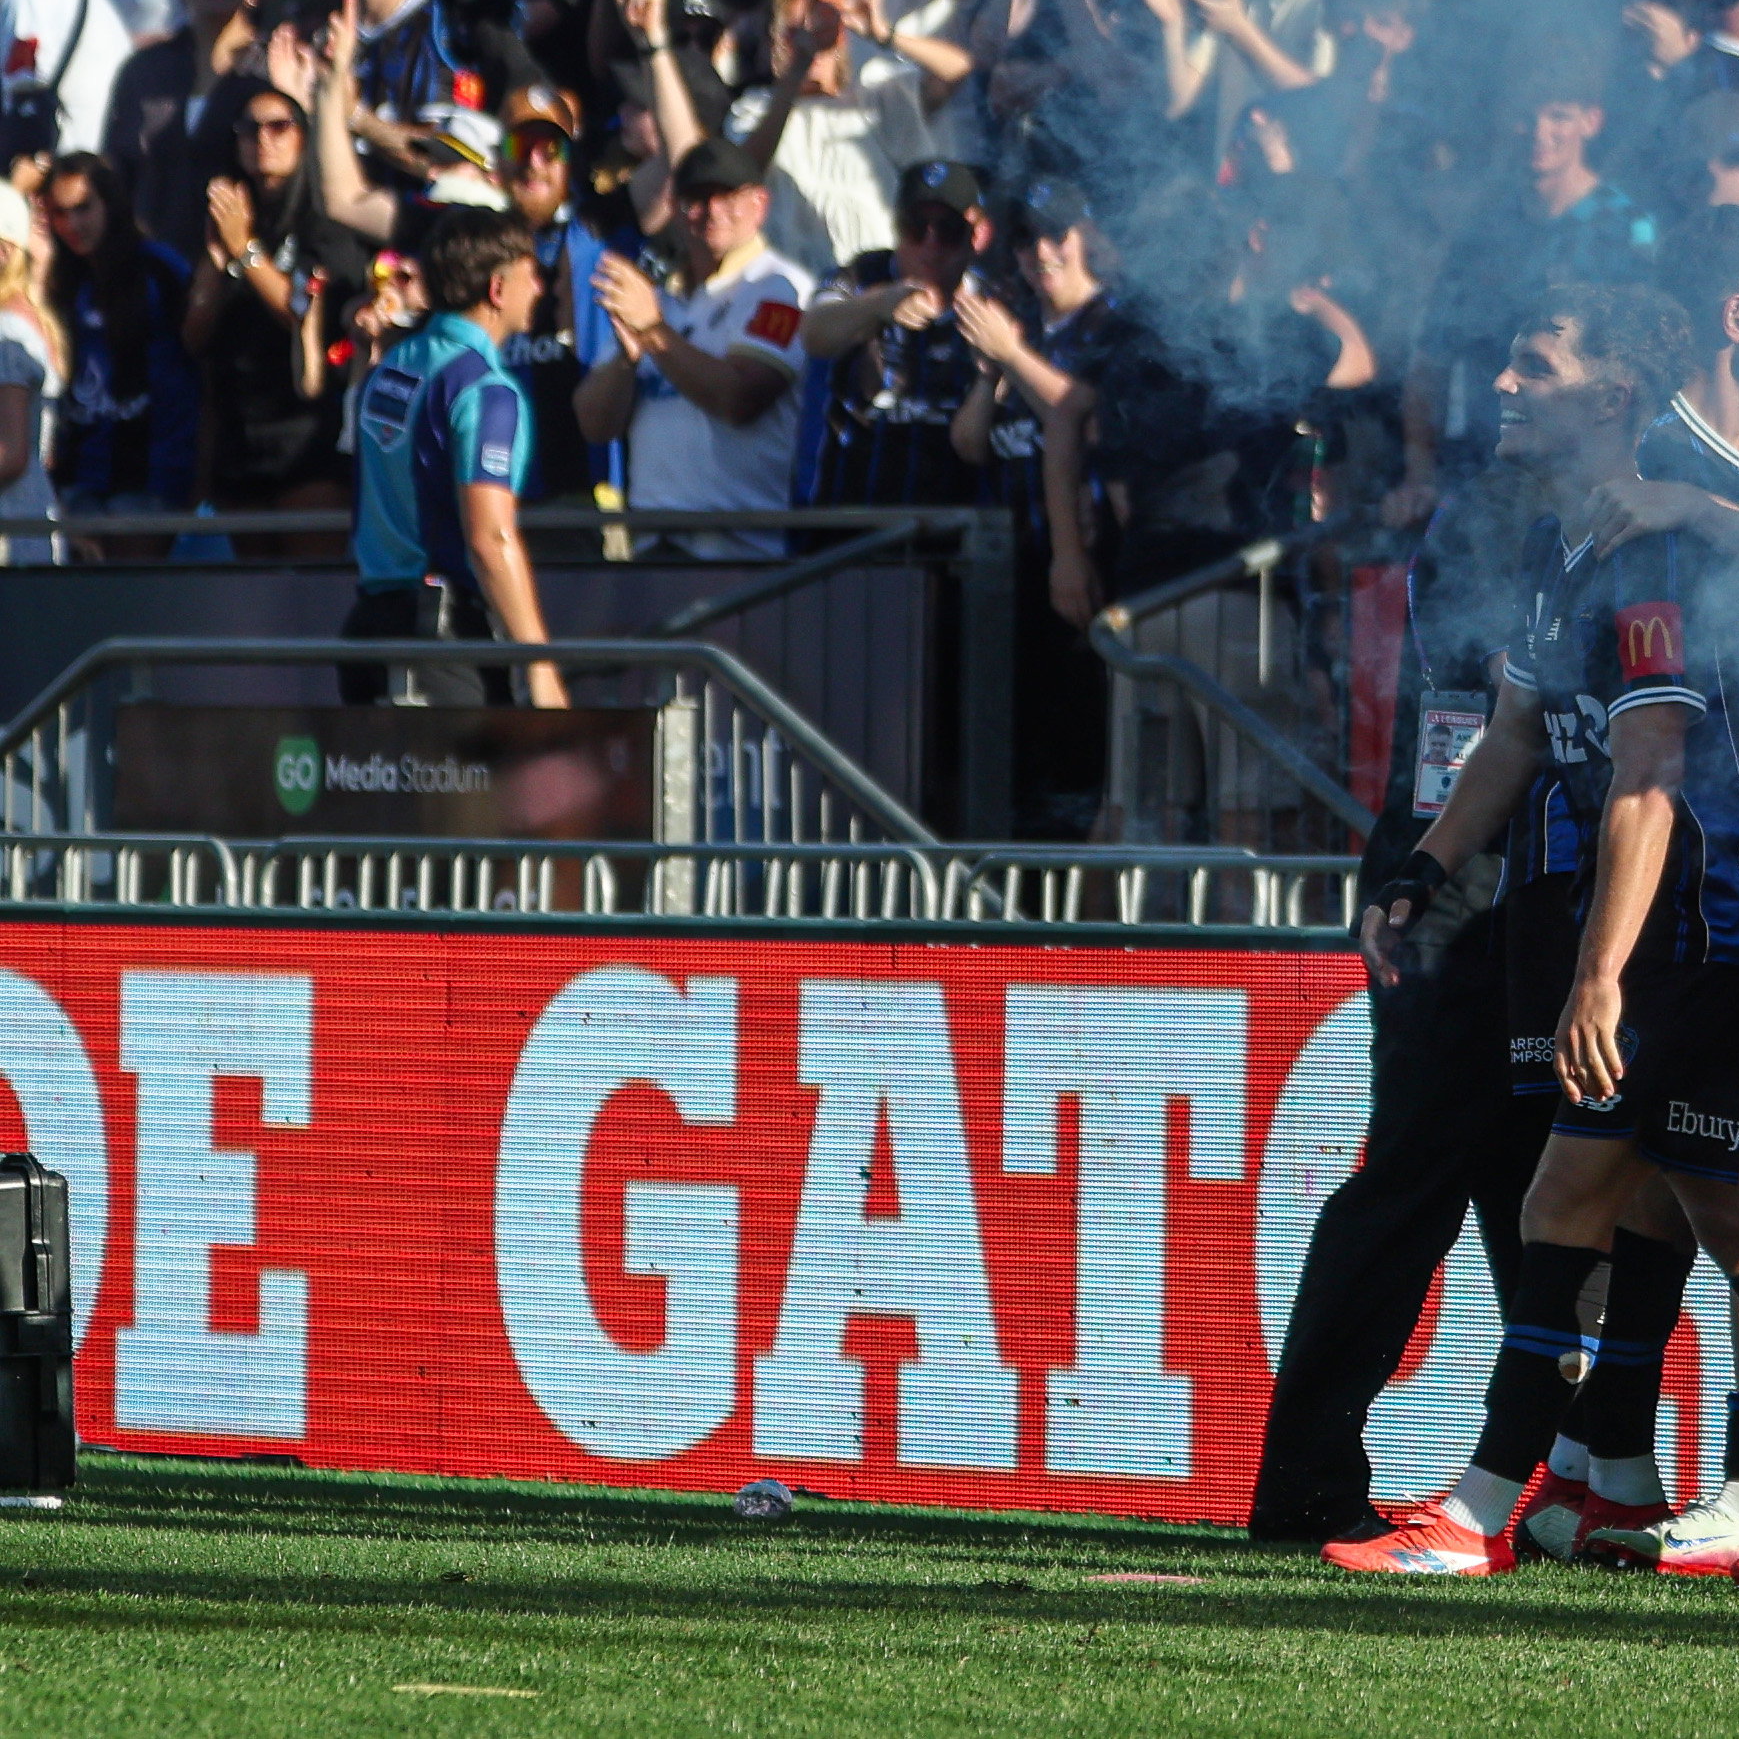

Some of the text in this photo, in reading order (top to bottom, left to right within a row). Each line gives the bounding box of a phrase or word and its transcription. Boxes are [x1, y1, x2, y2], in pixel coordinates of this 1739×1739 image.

[277, 752, 490, 794] GO Media Stadium
